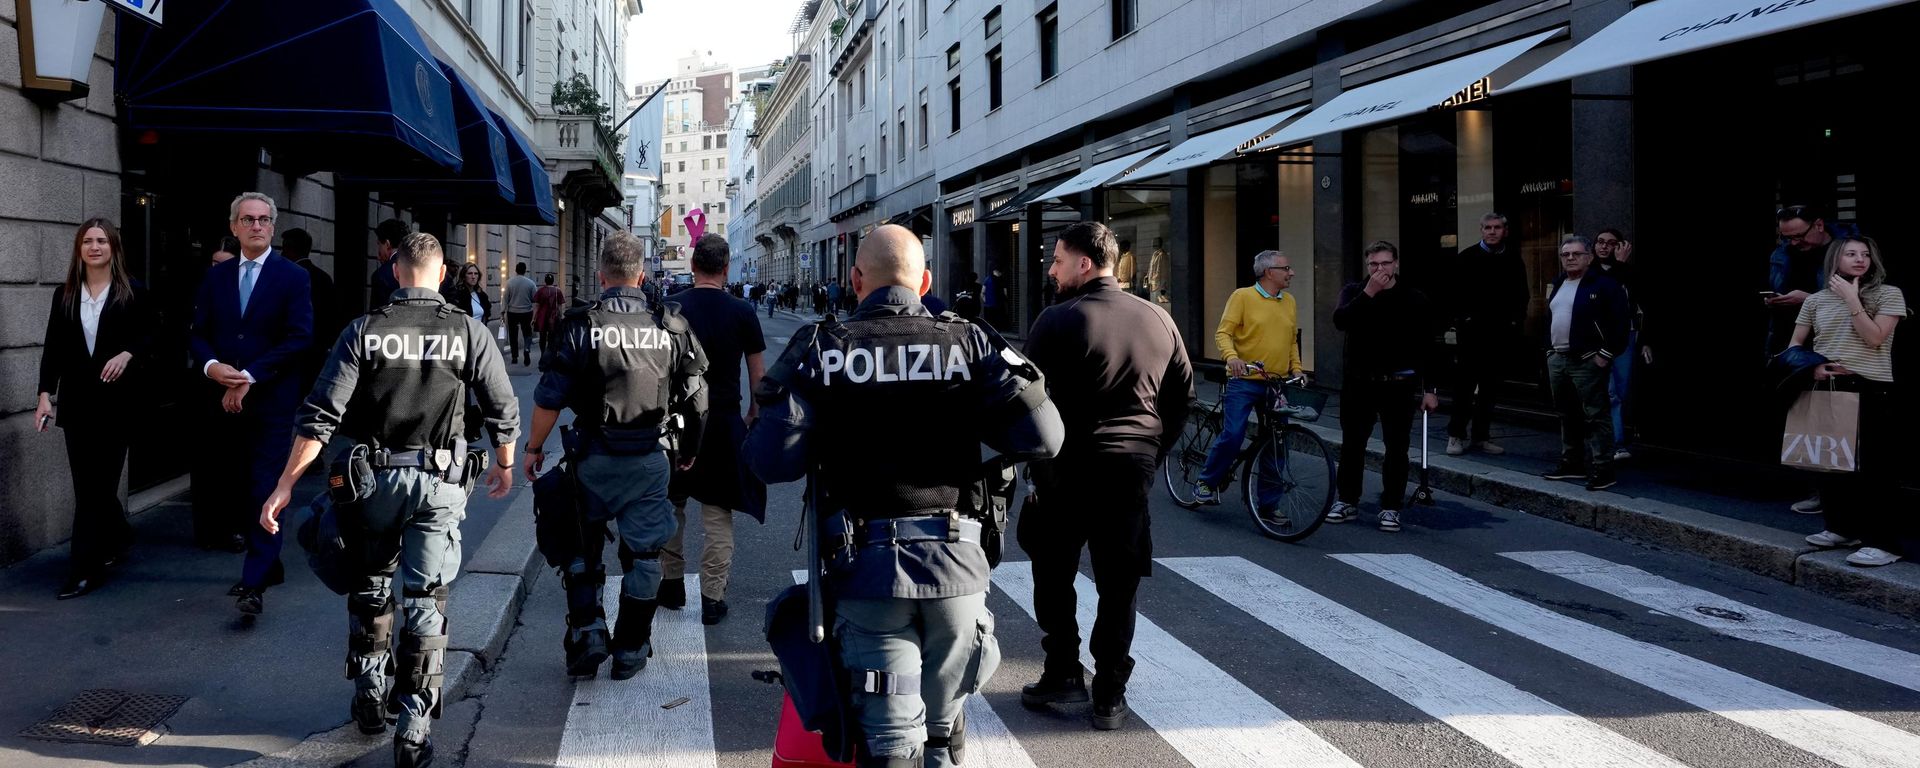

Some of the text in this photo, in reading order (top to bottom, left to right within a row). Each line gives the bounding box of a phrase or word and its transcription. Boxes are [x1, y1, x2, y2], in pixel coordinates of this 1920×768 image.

[364, 333, 466, 362] POLIZIA
[590, 326, 672, 350] POLIZIA
[822, 343, 972, 386] POLIZIA
[1780, 432, 1855, 471] ZARA
